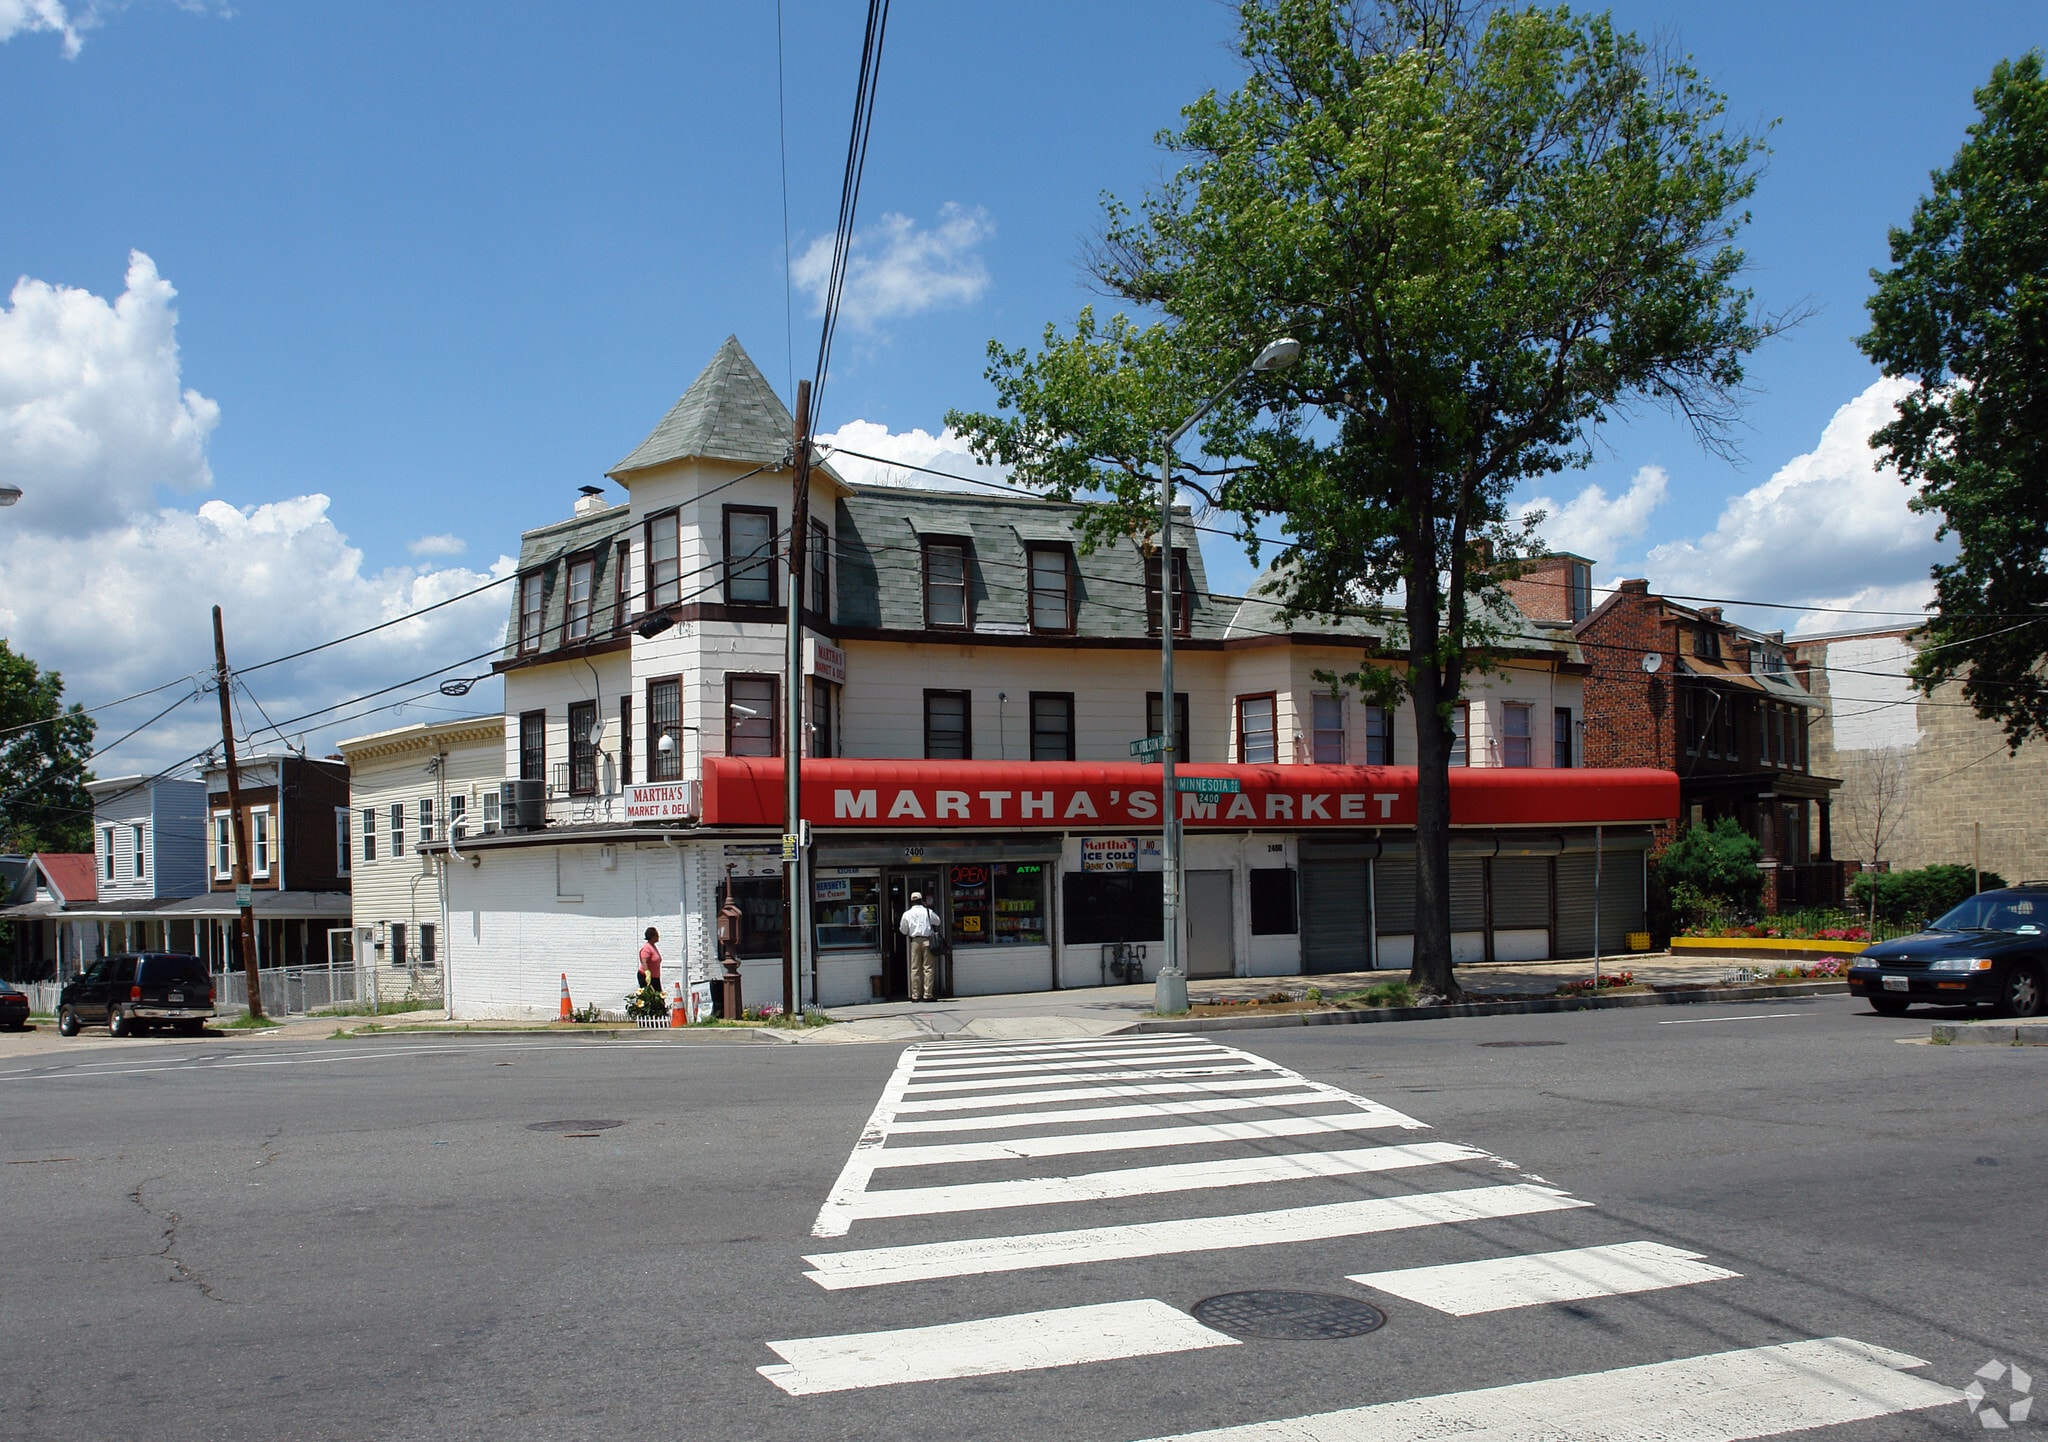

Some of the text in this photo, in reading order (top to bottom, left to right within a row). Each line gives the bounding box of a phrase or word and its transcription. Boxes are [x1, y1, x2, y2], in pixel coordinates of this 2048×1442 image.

[1179, 777, 1228, 792] MINNESOTA
[633, 787, 683, 802] MARTHA'S
[1199, 793, 1219, 803] 2400
[833, 789, 1400, 820] MARTHA'S MARKET
[627, 805, 660, 817] MARKET
[662, 804, 669, 815] &
[1084, 839, 1137, 850] Martha's
[1146, 840, 1155, 850] NO
[905, 847, 924, 856] 2400
[1083, 851, 1136, 860] ICE COLD
[950, 866, 989, 883] OPEN
[1016, 865, 1041, 874] ATM
